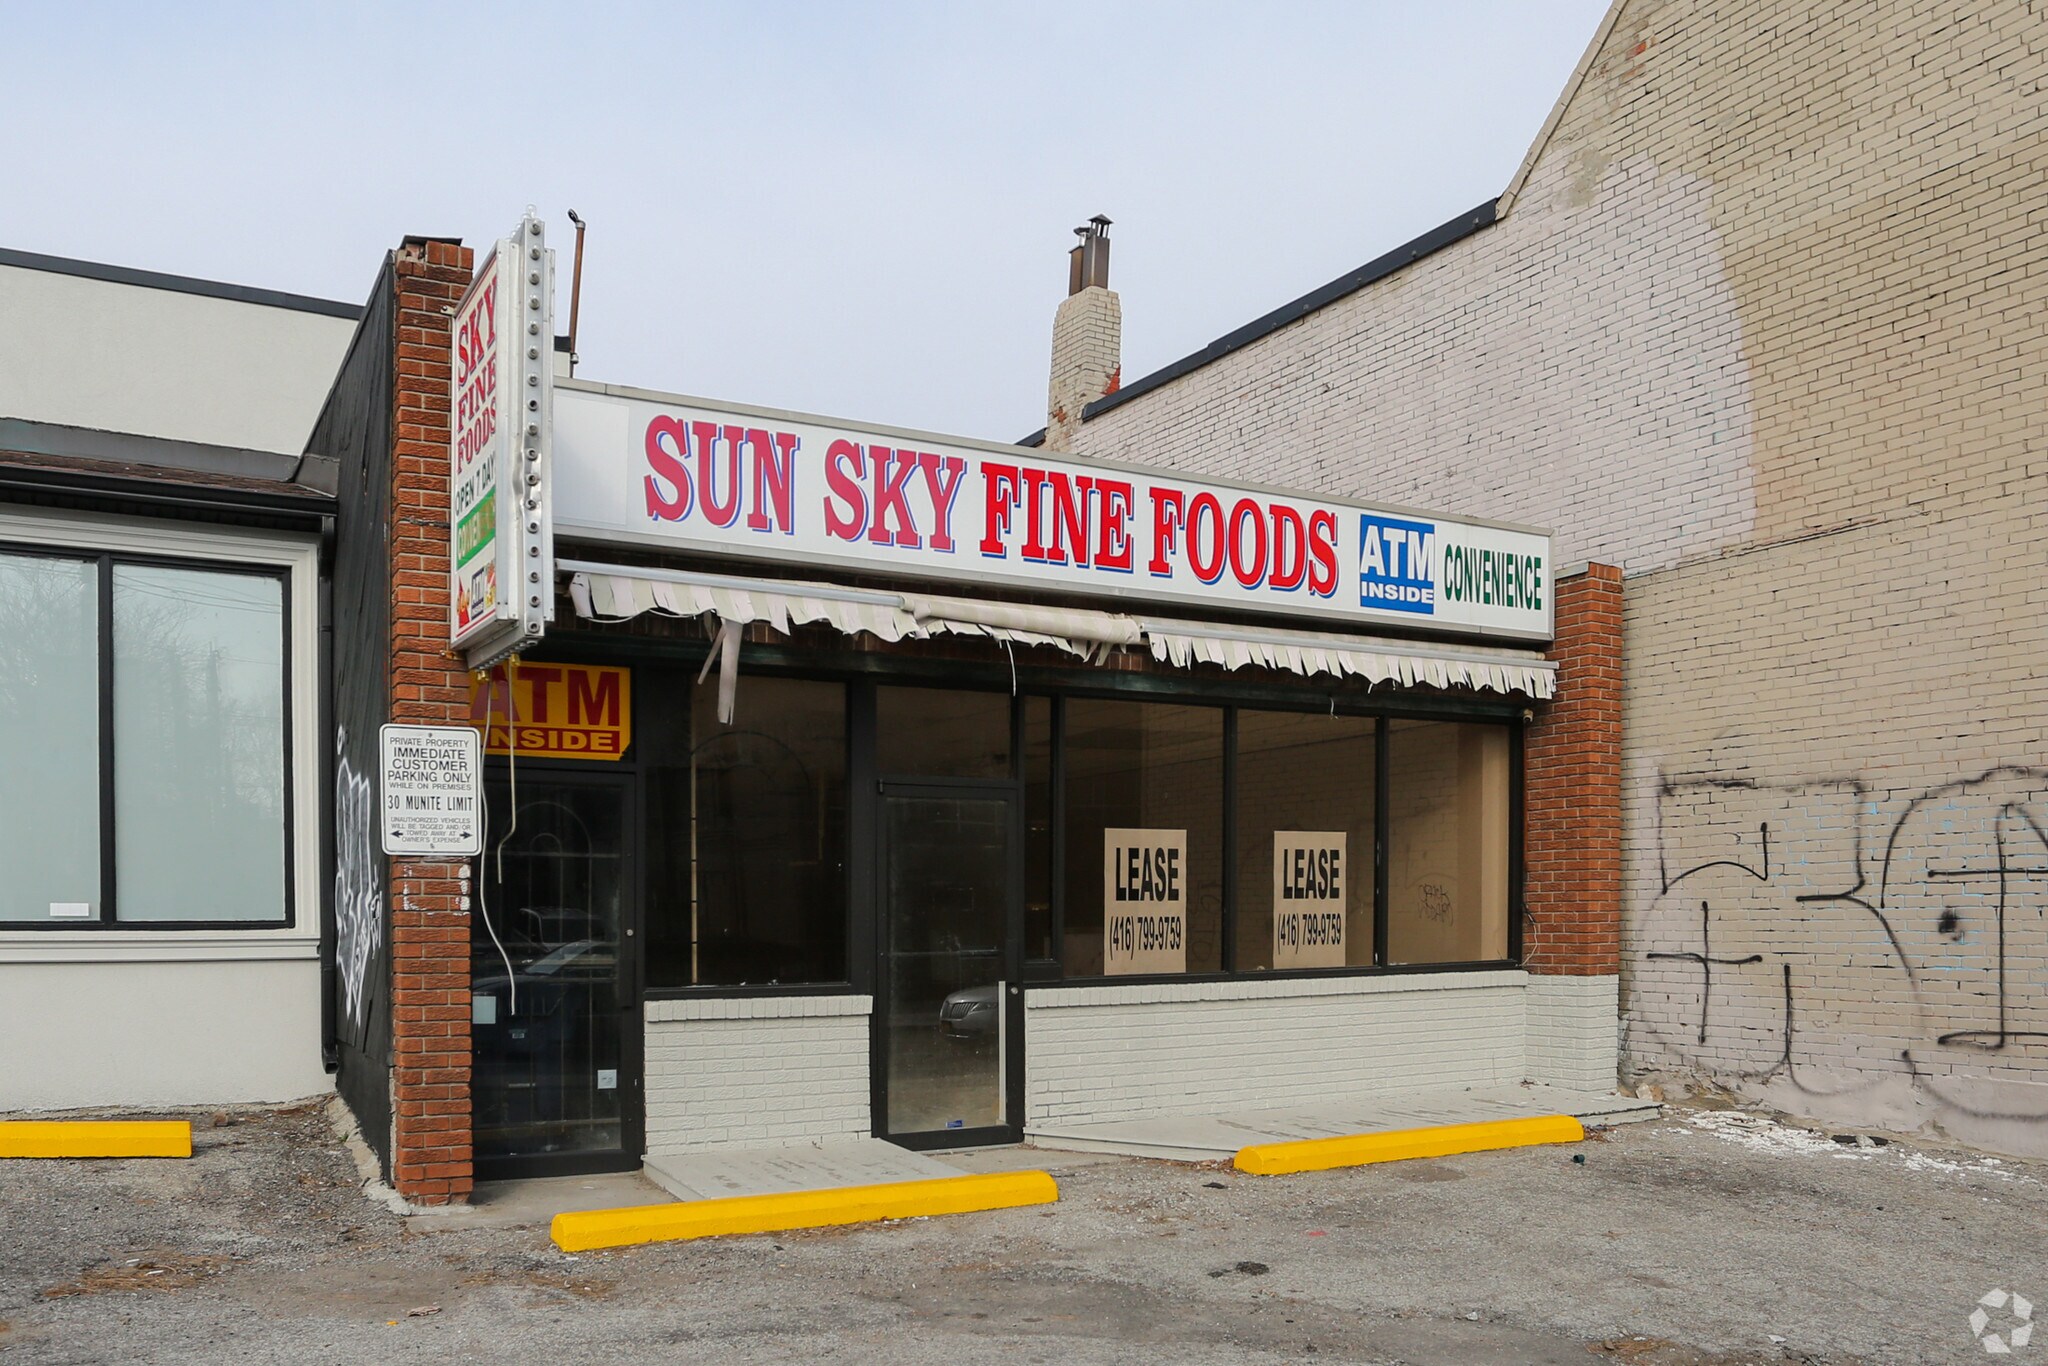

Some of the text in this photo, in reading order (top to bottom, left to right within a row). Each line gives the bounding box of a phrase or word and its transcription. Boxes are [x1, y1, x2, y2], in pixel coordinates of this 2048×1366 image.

[458, 274, 496, 388] SKY
[457, 352, 496, 434] FINE
[457, 397, 496, 475] FOODS
[455, 475, 474, 517] OPEN
[643, 414, 1339, 599] SUN SKY FINE FOODS
[1360, 524, 1435, 582] ATM
[1361, 581, 1434, 604] INSIDE
[1444, 543, 1542, 610] CONVENIENCE
[470, 665, 620, 726] ATM
[390, 737, 469, 748] PRIVATE PROPERTY
[392, 759, 468, 771] CUSTOMER
[394, 747, 466, 759] IMMEDIATE
[388, 770, 472, 783] PARKING ONLY
[432, 783, 472, 791] PREMISES
[388, 795, 473, 811] 30 MUNITE LIMIT
[1115, 847, 1180, 902] LEASE
[1283, 849, 1340, 900] LEASE
[1109, 915, 1135, 961] (416)
[1137, 915, 1181, 951] 799-9759
[1277, 912, 1341, 955] (416) 799-9759
